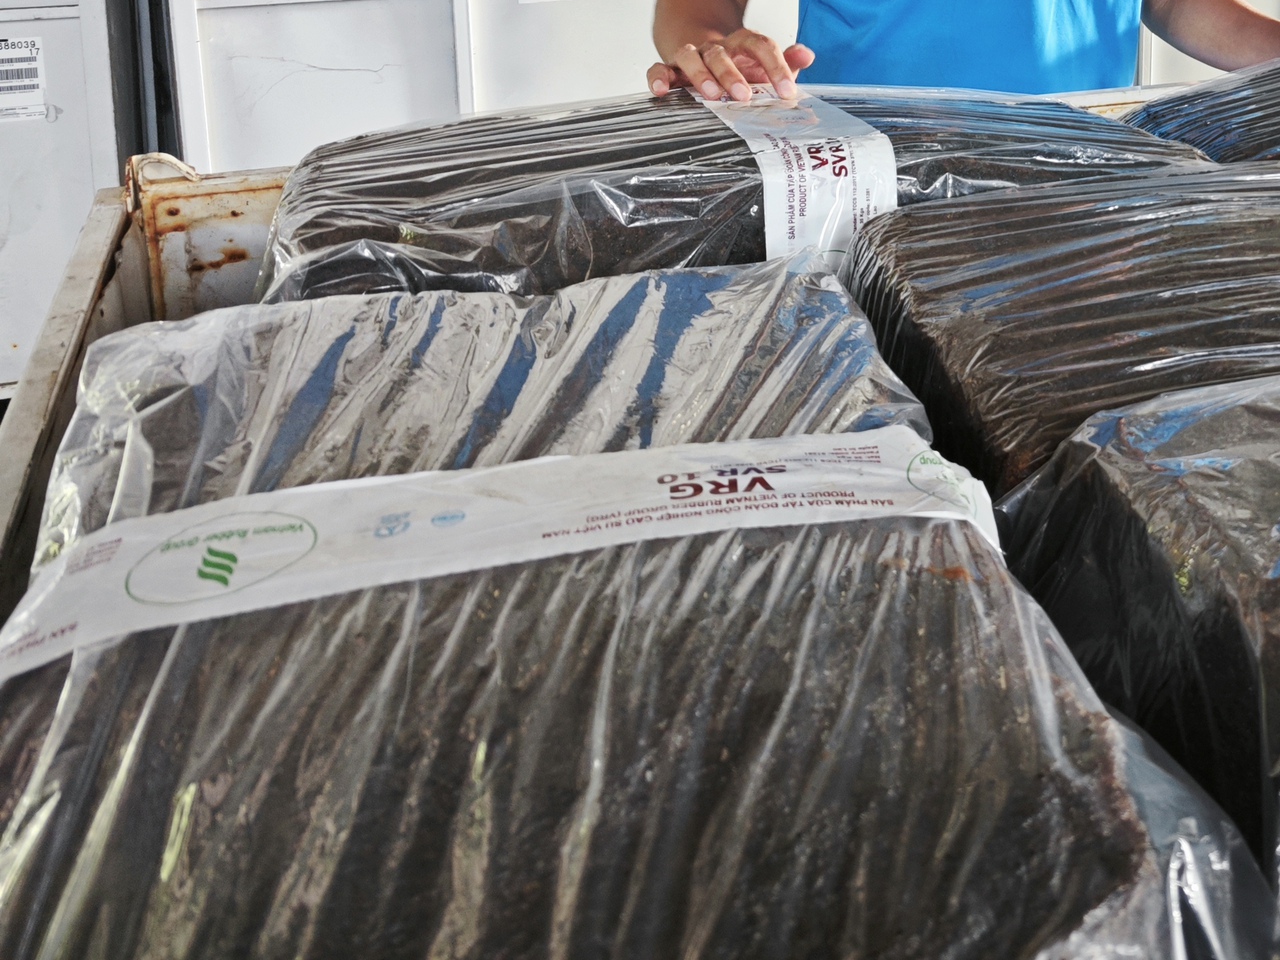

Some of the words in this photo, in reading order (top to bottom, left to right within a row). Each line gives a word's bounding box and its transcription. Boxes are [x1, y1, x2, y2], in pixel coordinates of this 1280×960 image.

[29, 47, 40, 56] 17
[827, 143, 850, 178] SVR
[797, 172, 807, 183] OF
[797, 183, 809, 217] PRODUCT
[716, 464, 787, 478] SVR
[656, 471, 701, 485] 10
[669, 476, 776, 500] VRG
[799, 490, 855, 499] PRODUCT
[725, 493, 778, 506] VIETNAM
[780, 492, 798, 500] OF
